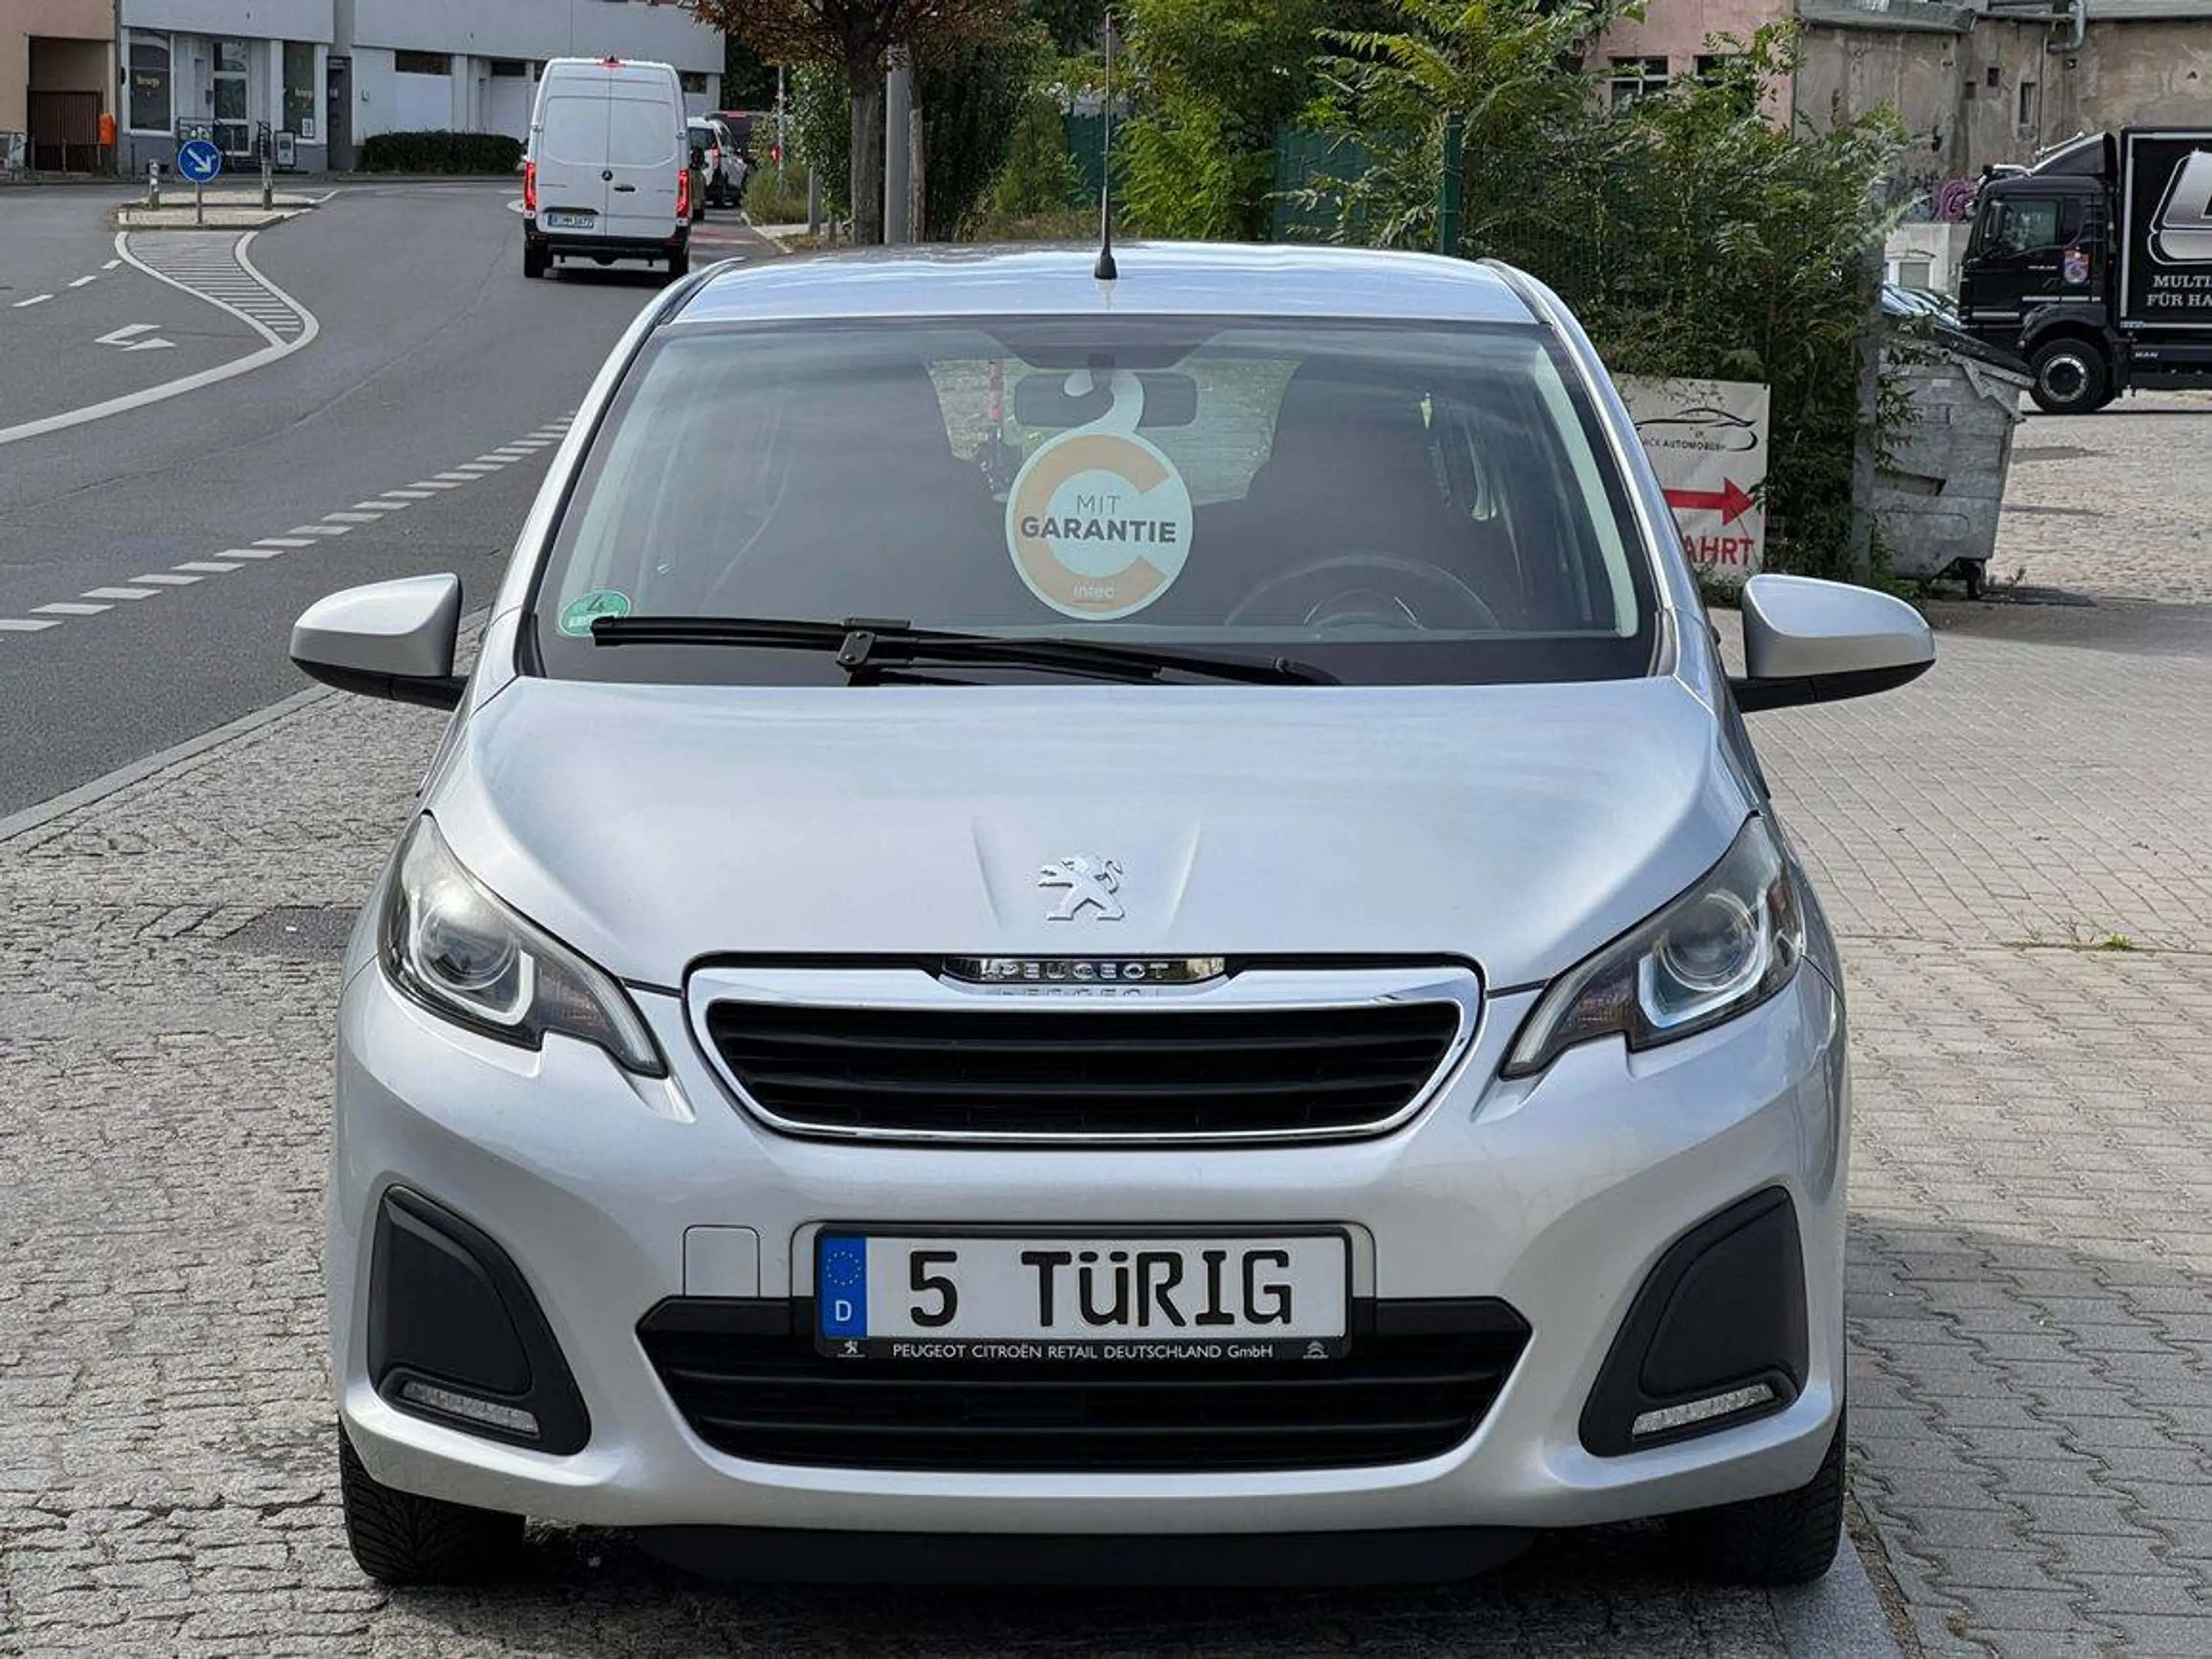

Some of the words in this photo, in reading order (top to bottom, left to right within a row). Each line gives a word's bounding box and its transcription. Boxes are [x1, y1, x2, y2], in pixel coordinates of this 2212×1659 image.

[2147, 292, 2183, 306] FÜR
[1077, 495, 1120, 515] MIT
[1021, 516, 1176, 543] GARANTIE
[999, 963, 1168, 979] PEUGEOT
[910, 1251, 958, 1327] 5
[835, 1300, 852, 1321] D
[892, 1344, 967, 1358] PEUGEOT
[972, 1343, 1042, 1358] CITROËN
[1048, 1345, 1097, 1359] RETAIL
[1104, 1344, 1221, 1359] DEUTSCHLAND
[1227, 1345, 1274, 1359] GmbH
